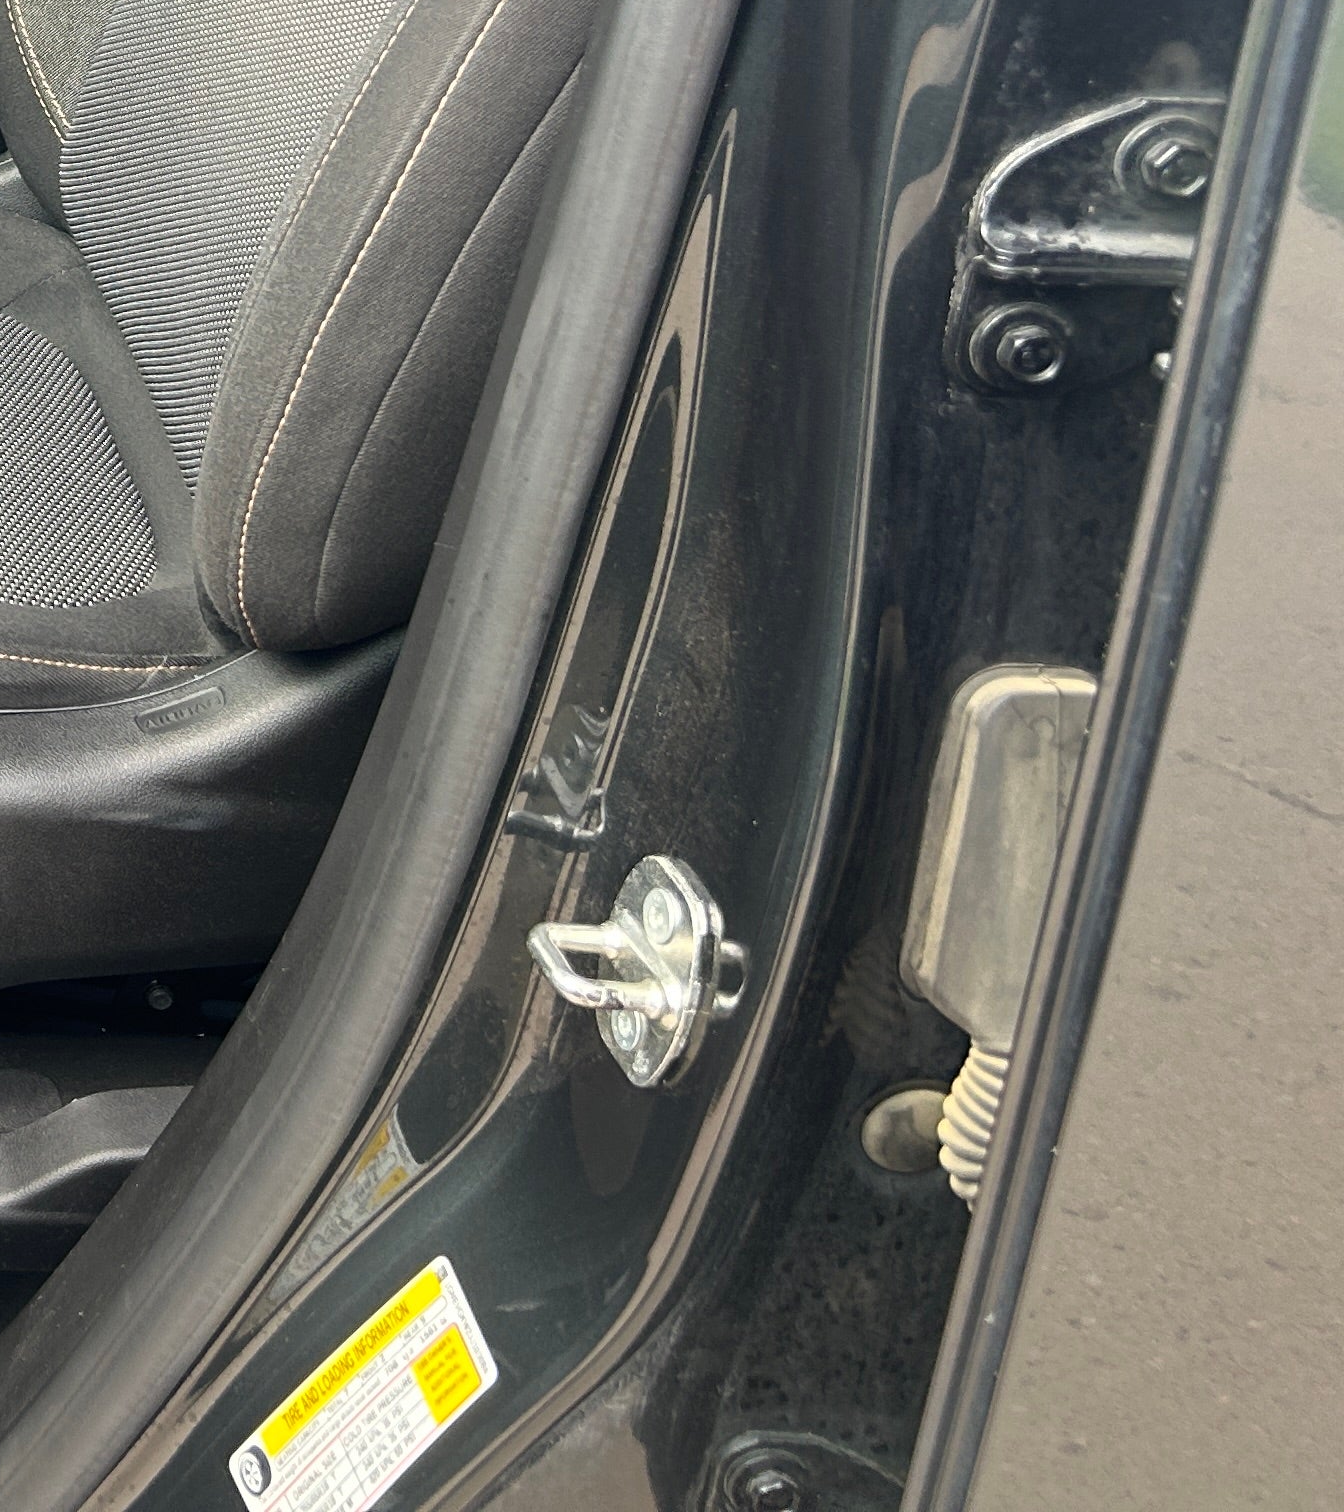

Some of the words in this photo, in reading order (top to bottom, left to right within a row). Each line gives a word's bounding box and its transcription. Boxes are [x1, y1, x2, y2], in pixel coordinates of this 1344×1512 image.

[281, 1401, 303, 1430] TIRE
[299, 1384, 320, 1412] AND
[316, 1350, 355, 1396] LOADING
[351, 1297, 409, 1361] INFORMATION
